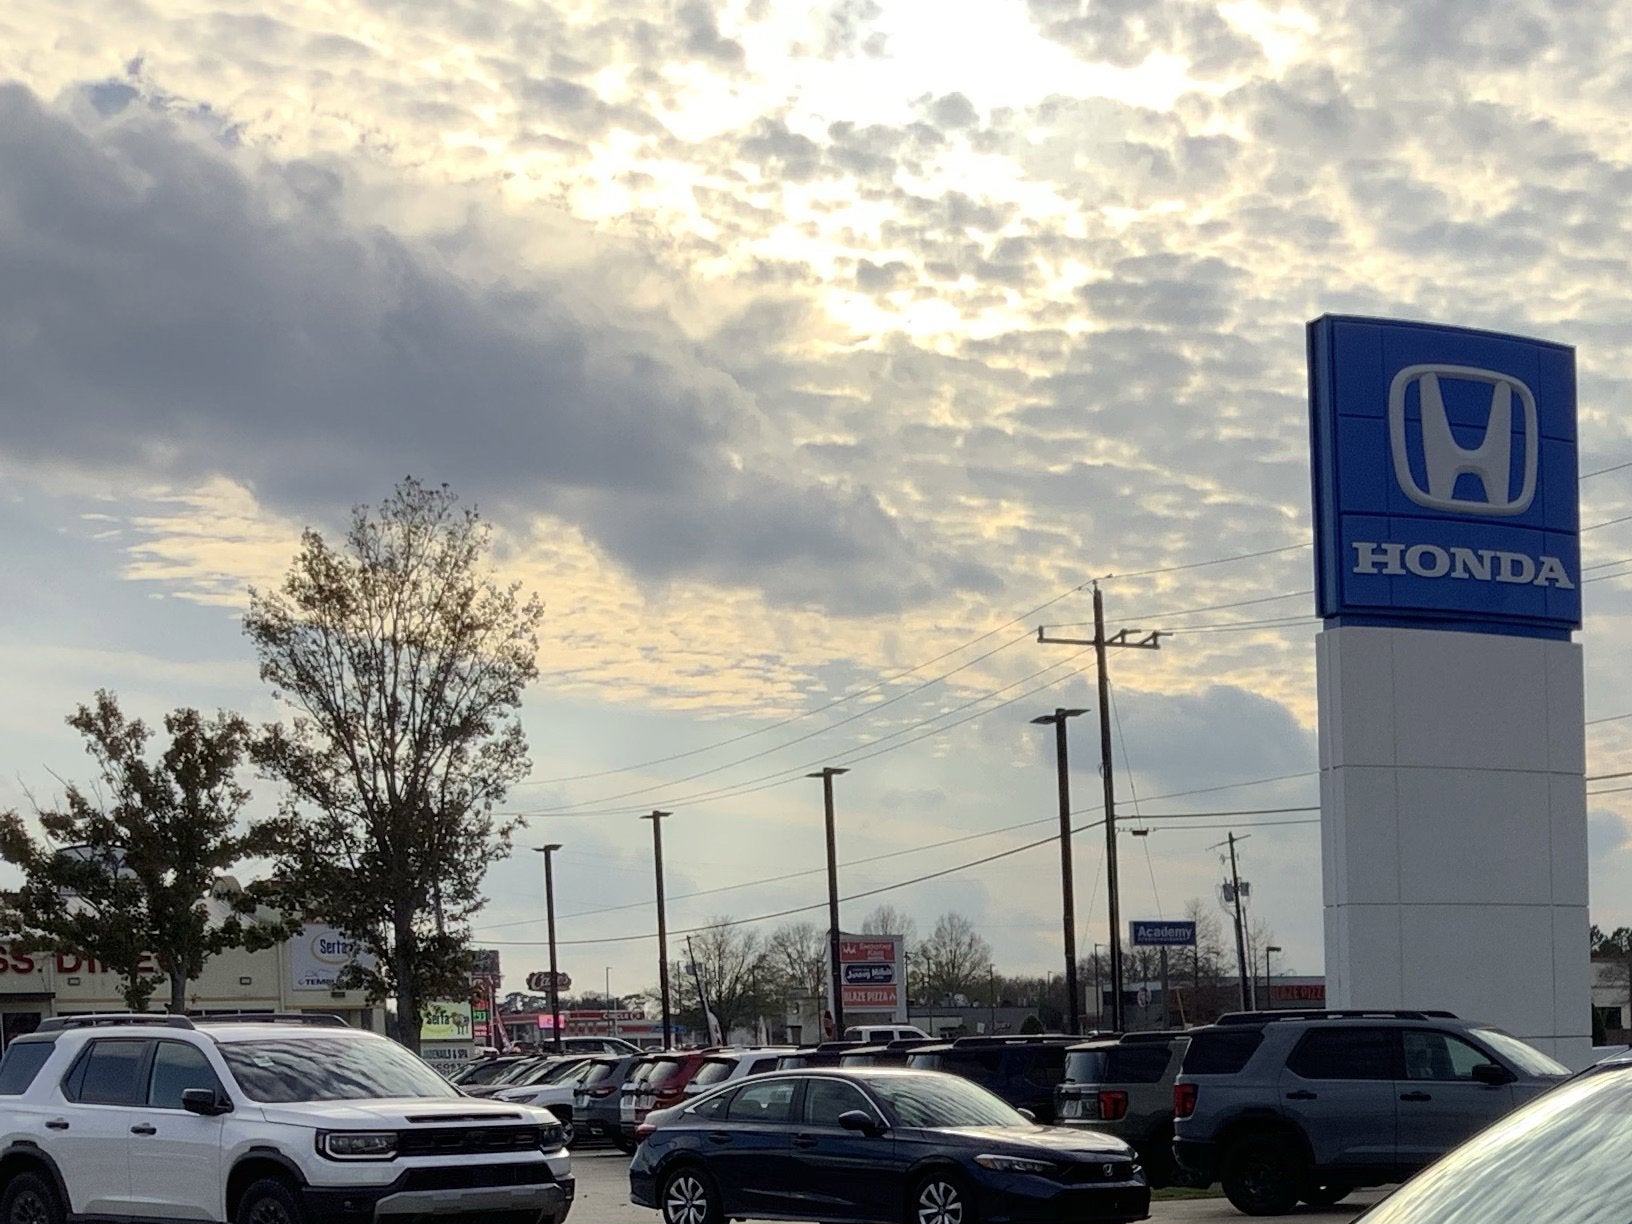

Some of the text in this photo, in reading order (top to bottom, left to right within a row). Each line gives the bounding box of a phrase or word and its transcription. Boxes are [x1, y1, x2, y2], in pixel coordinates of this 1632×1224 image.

[1352, 542, 1575, 590] HONDA
[1138, 926, 1192, 940] Academy
[843, 991, 888, 1001] BLAZE PIZZA
